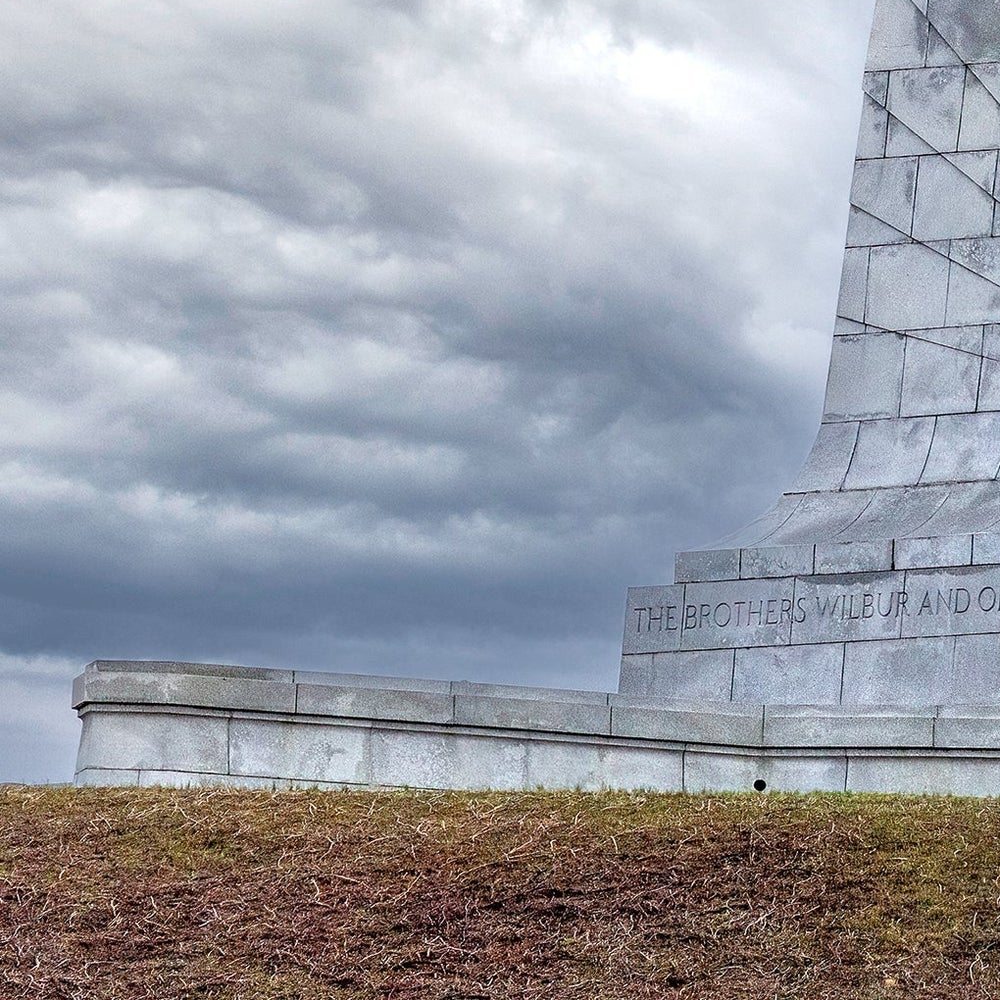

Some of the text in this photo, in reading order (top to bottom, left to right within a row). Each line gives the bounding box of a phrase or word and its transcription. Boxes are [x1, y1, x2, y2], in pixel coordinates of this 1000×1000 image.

[634, 605, 677, 633] THE
[684, 598, 806, 630] BROTHERS
[815, 591, 909, 620] WILBUR
[917, 588, 970, 616] AND
